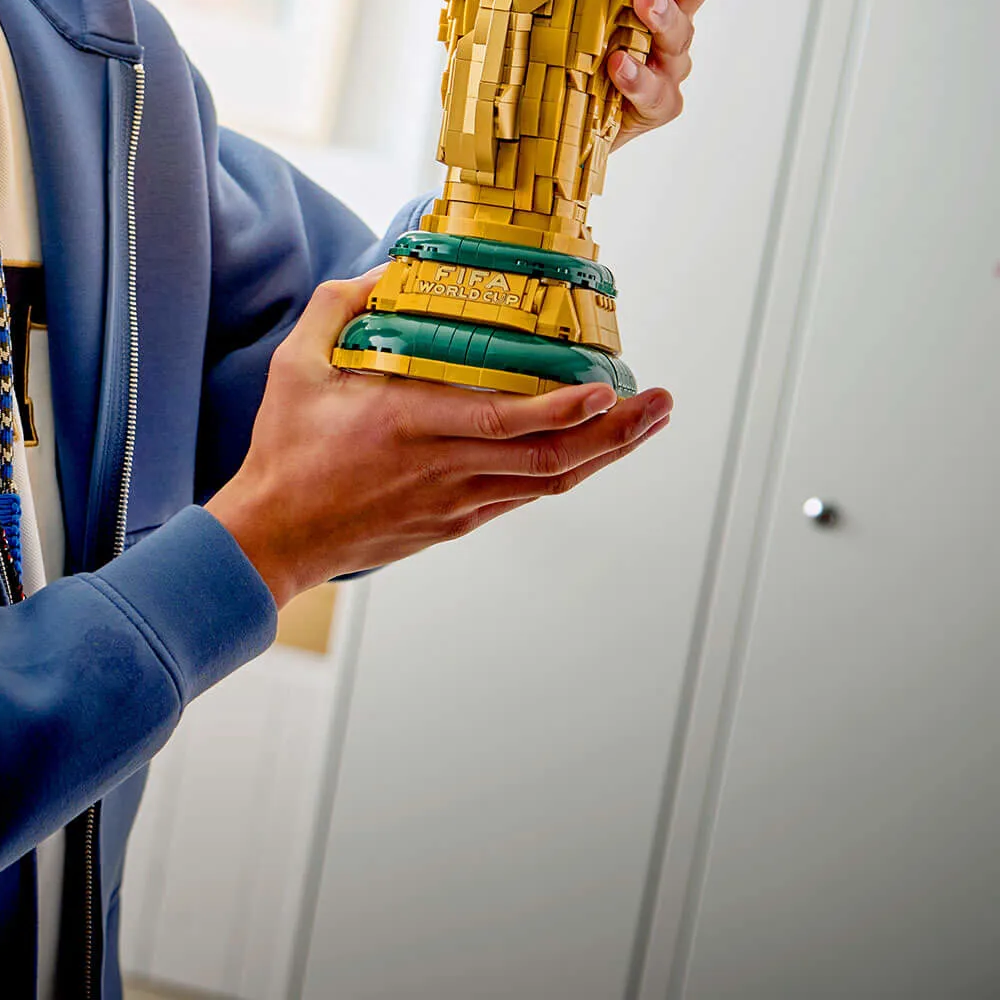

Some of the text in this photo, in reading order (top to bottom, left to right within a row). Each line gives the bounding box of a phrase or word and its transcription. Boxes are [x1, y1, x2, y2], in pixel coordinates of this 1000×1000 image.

[435, 264, 510, 292] FIFA
[420, 281, 520, 305] WORLD CUP
